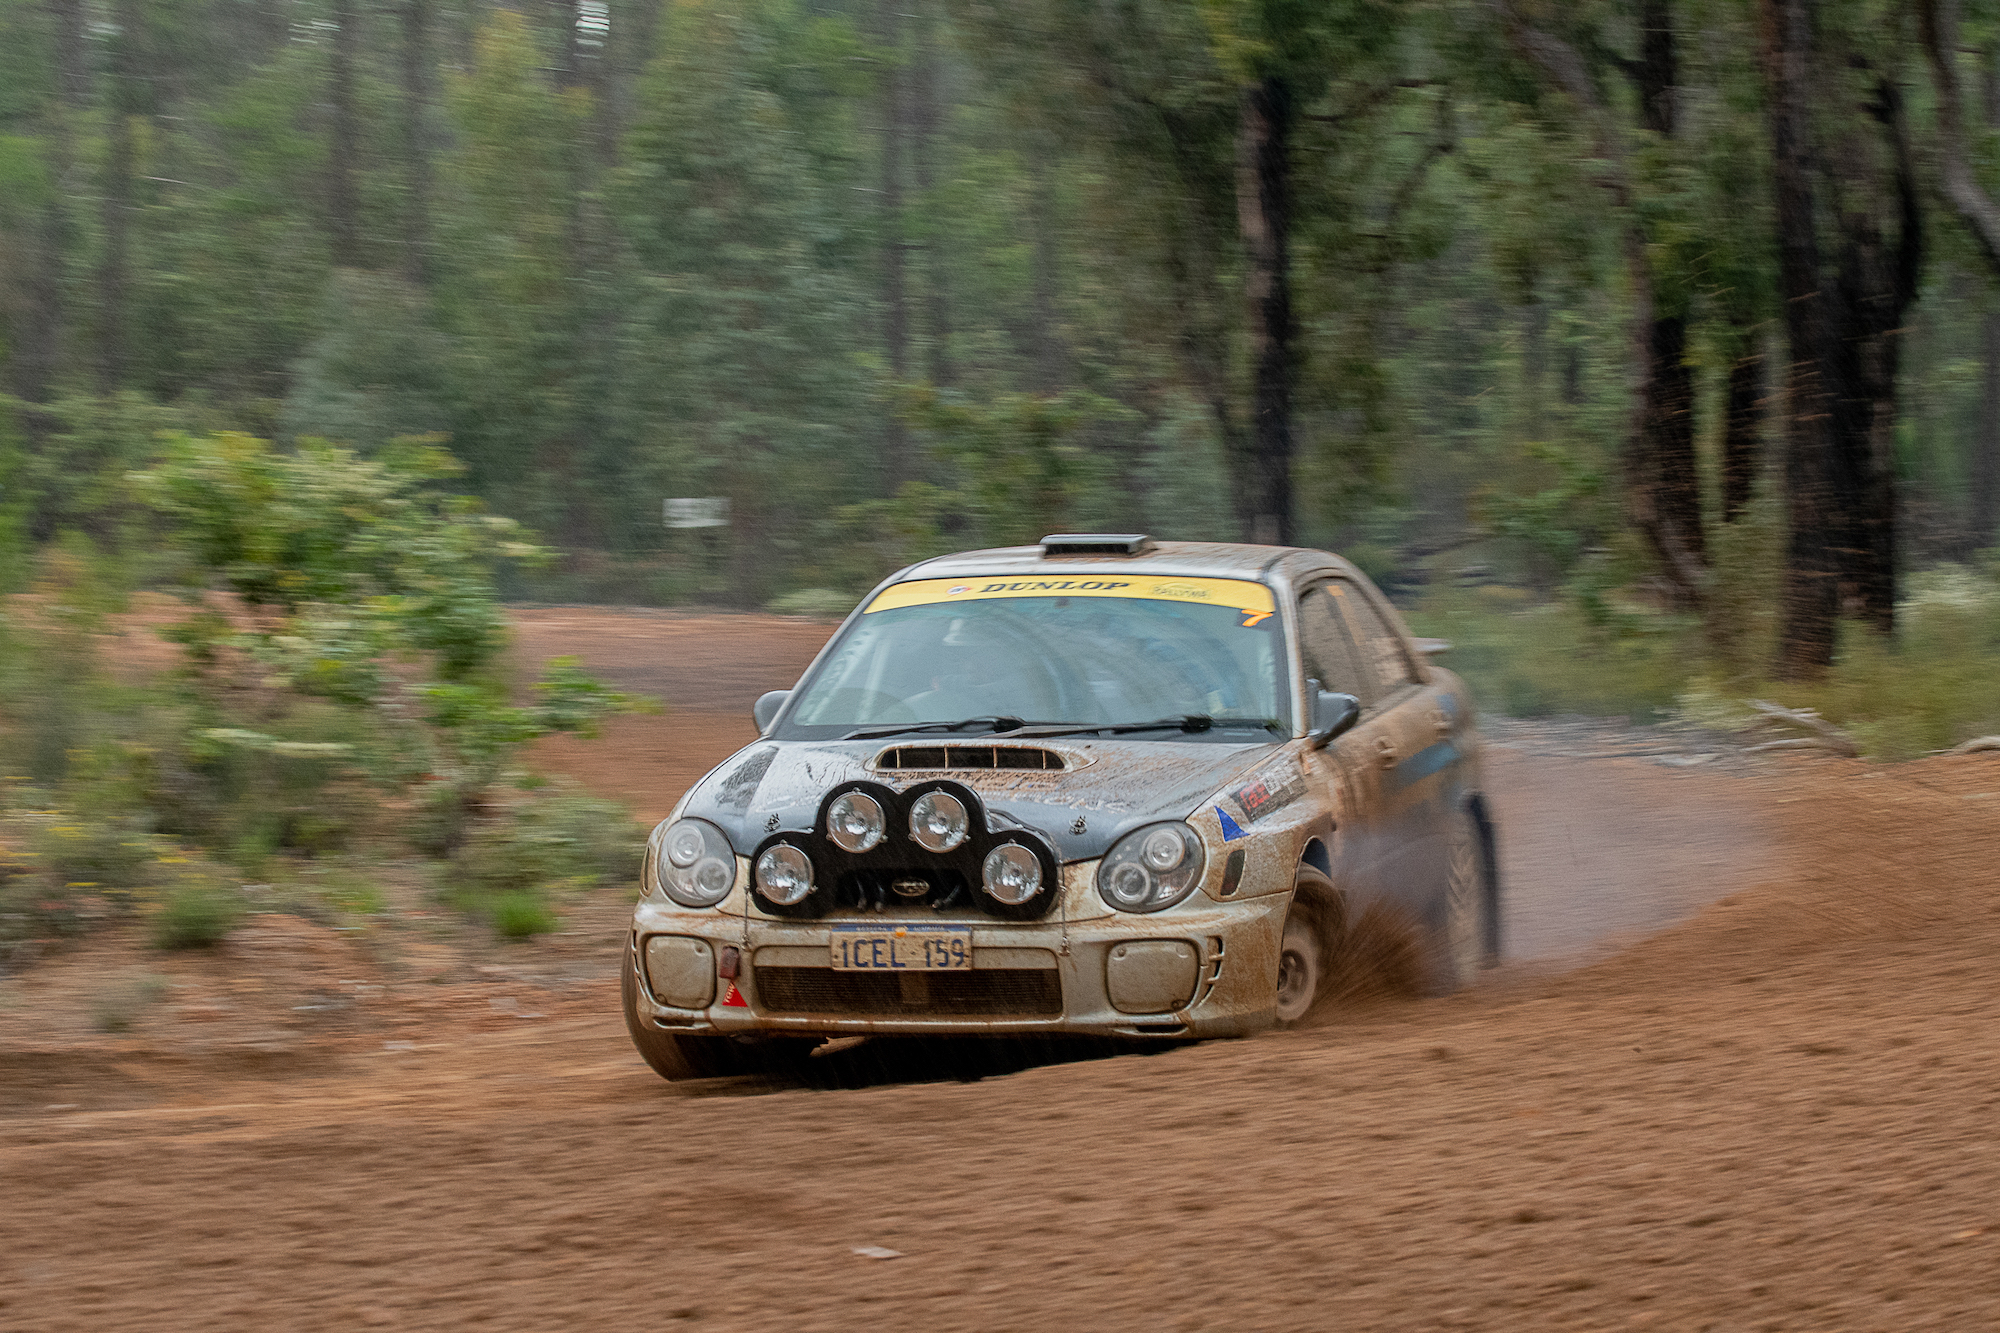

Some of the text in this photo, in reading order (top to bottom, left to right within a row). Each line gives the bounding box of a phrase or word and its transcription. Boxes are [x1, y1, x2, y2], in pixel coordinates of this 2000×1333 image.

[979, 580, 1132, 593] DUNLOP
[1241, 608, 1274, 627] 7
[842, 939, 964, 968] 1CEL 159
[723, 982, 735, 1003] TOW
